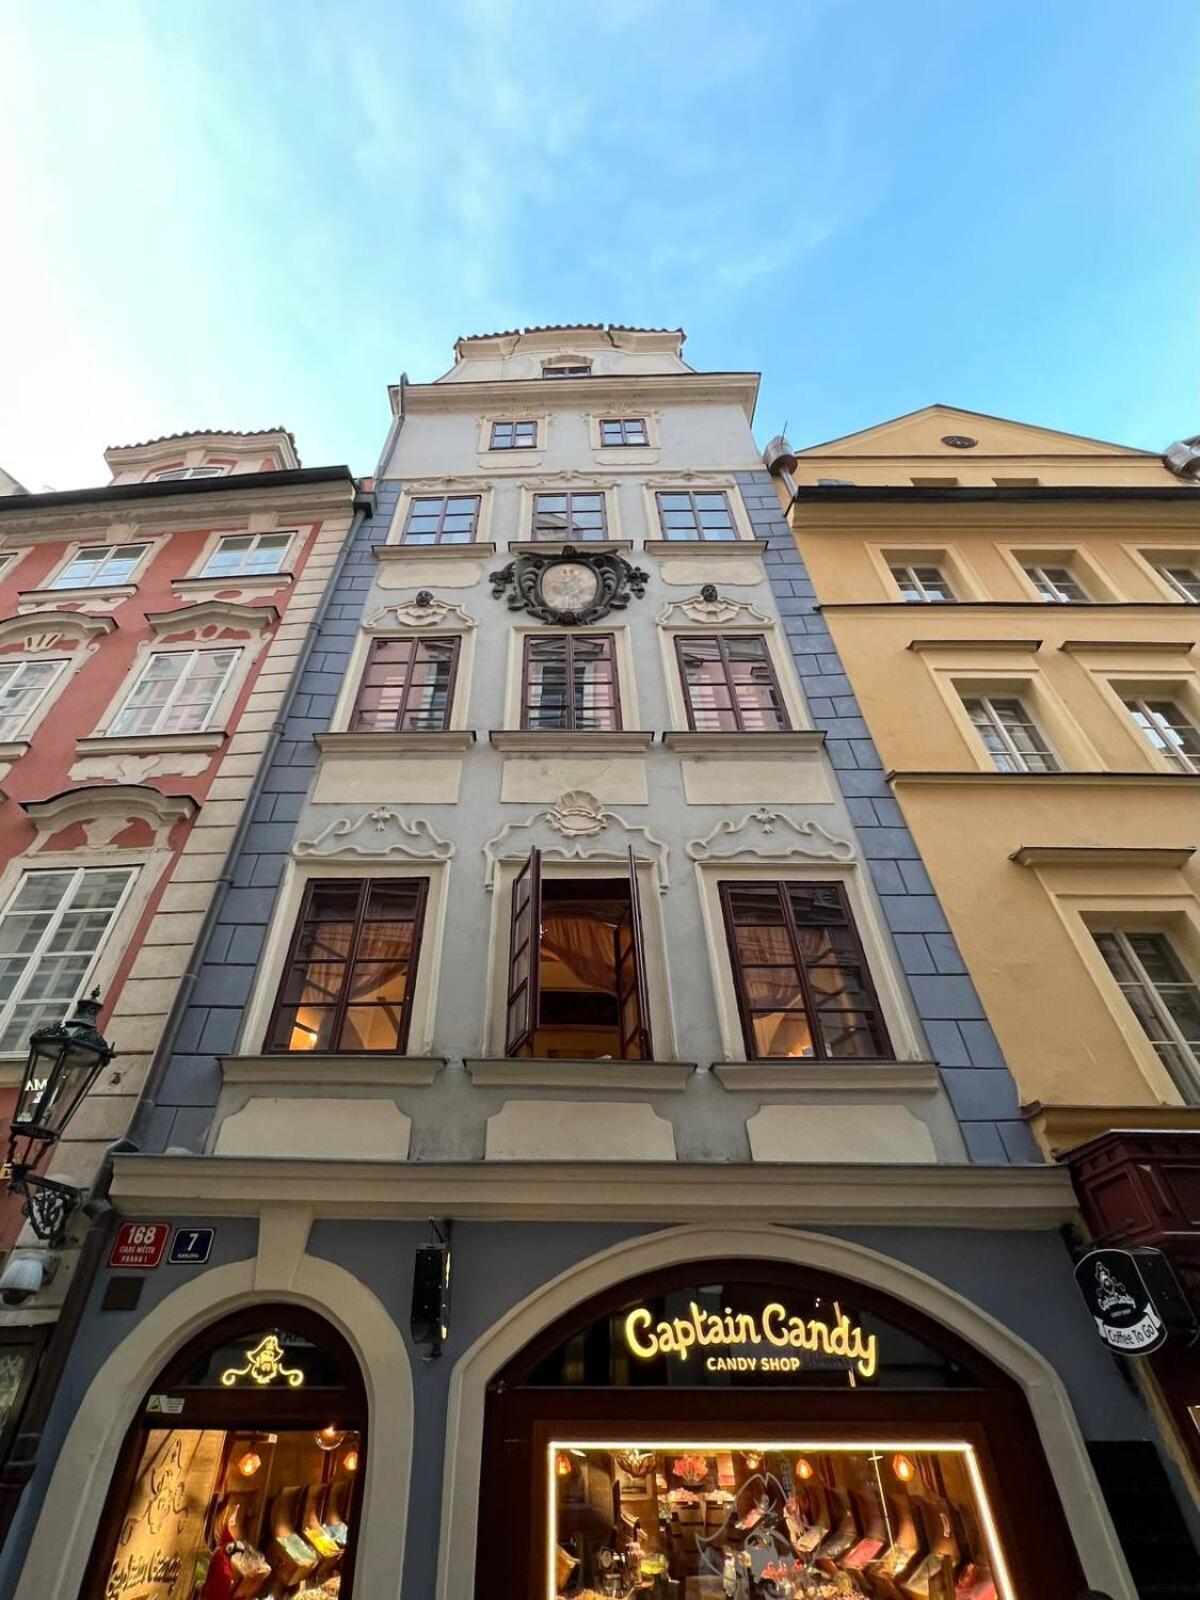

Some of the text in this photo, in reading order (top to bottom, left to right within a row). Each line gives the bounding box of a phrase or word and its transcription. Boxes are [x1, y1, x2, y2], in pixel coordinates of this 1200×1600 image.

[128, 1226, 156, 1244] 168
[188, 1233, 199, 1251] 7
[625, 1301, 876, 1377] Captain Candy
[1107, 1330, 1135, 1345] Coffee
[1131, 1330, 1145, 1344] To
[706, 1357, 801, 1372] CANDY SHOP
